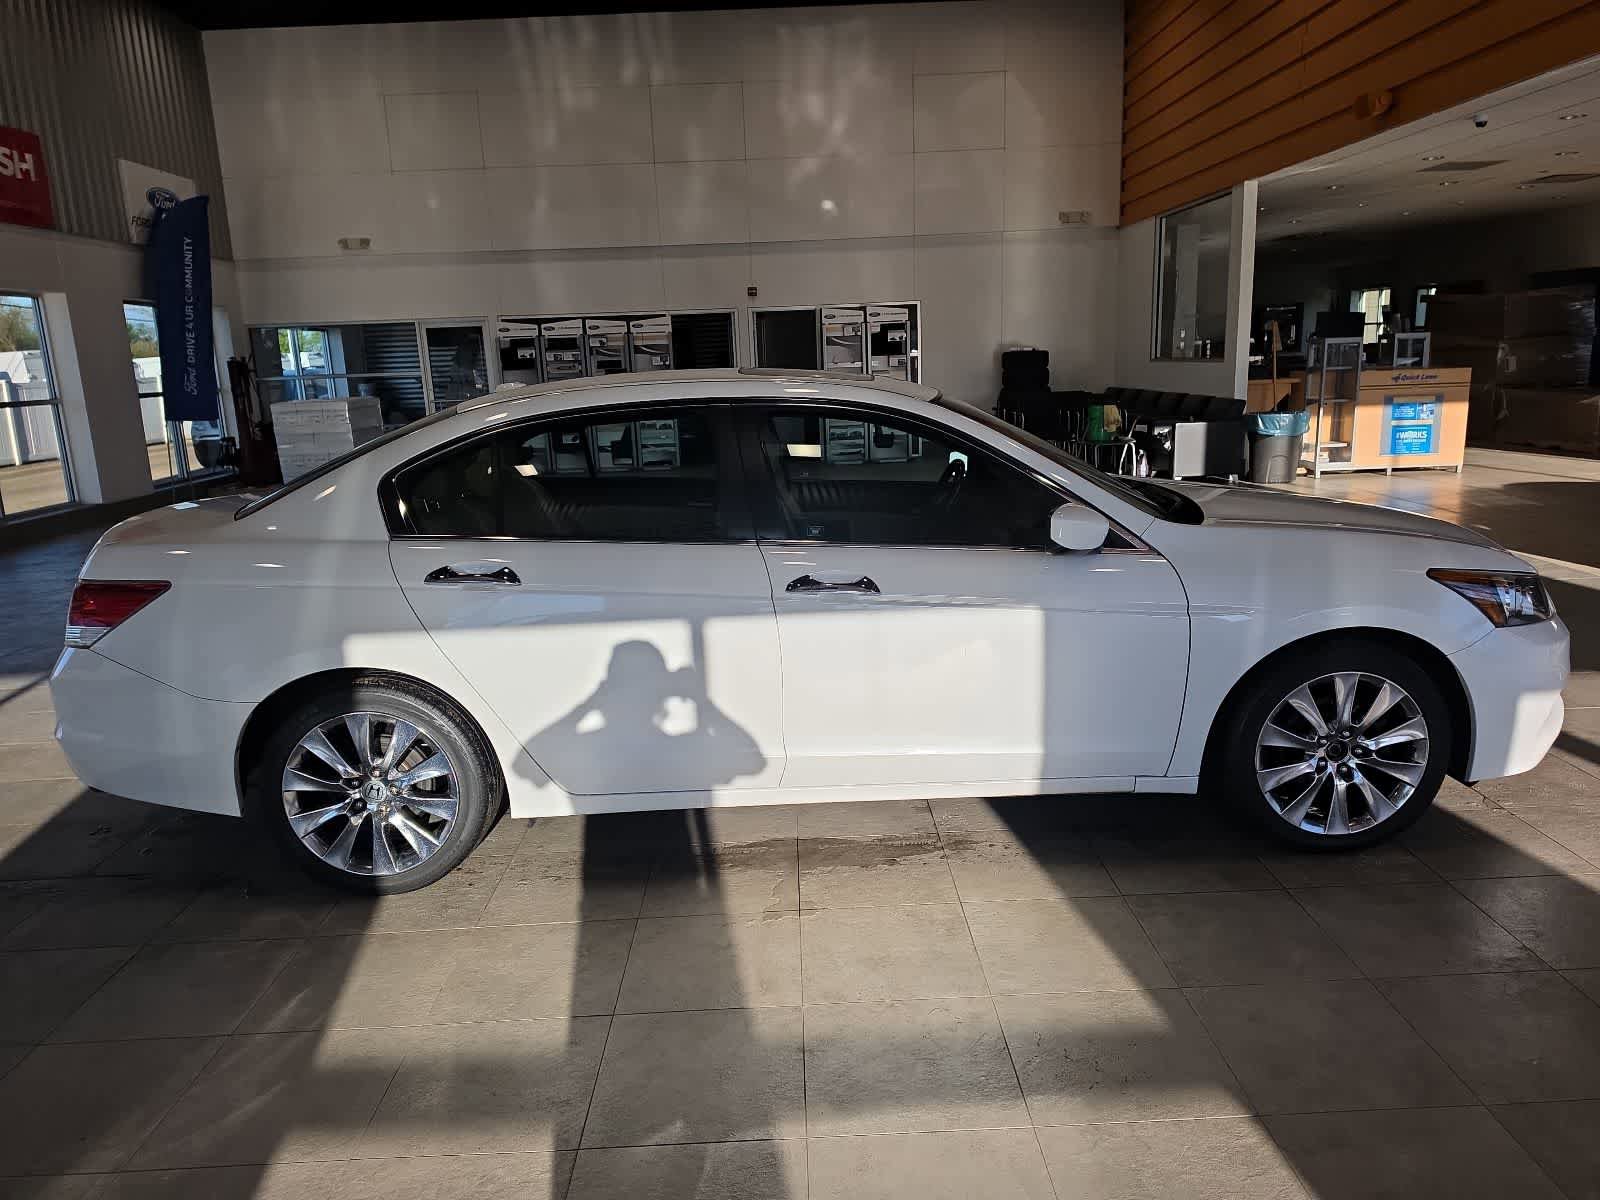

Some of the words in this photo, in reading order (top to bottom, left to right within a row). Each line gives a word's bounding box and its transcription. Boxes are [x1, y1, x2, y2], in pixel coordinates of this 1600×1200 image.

[183, 235, 194, 303] COMMUNITY
[185, 304, 194, 320] UR
[185, 331, 195, 364] DRIVE
[184, 367, 197, 395] Ford
